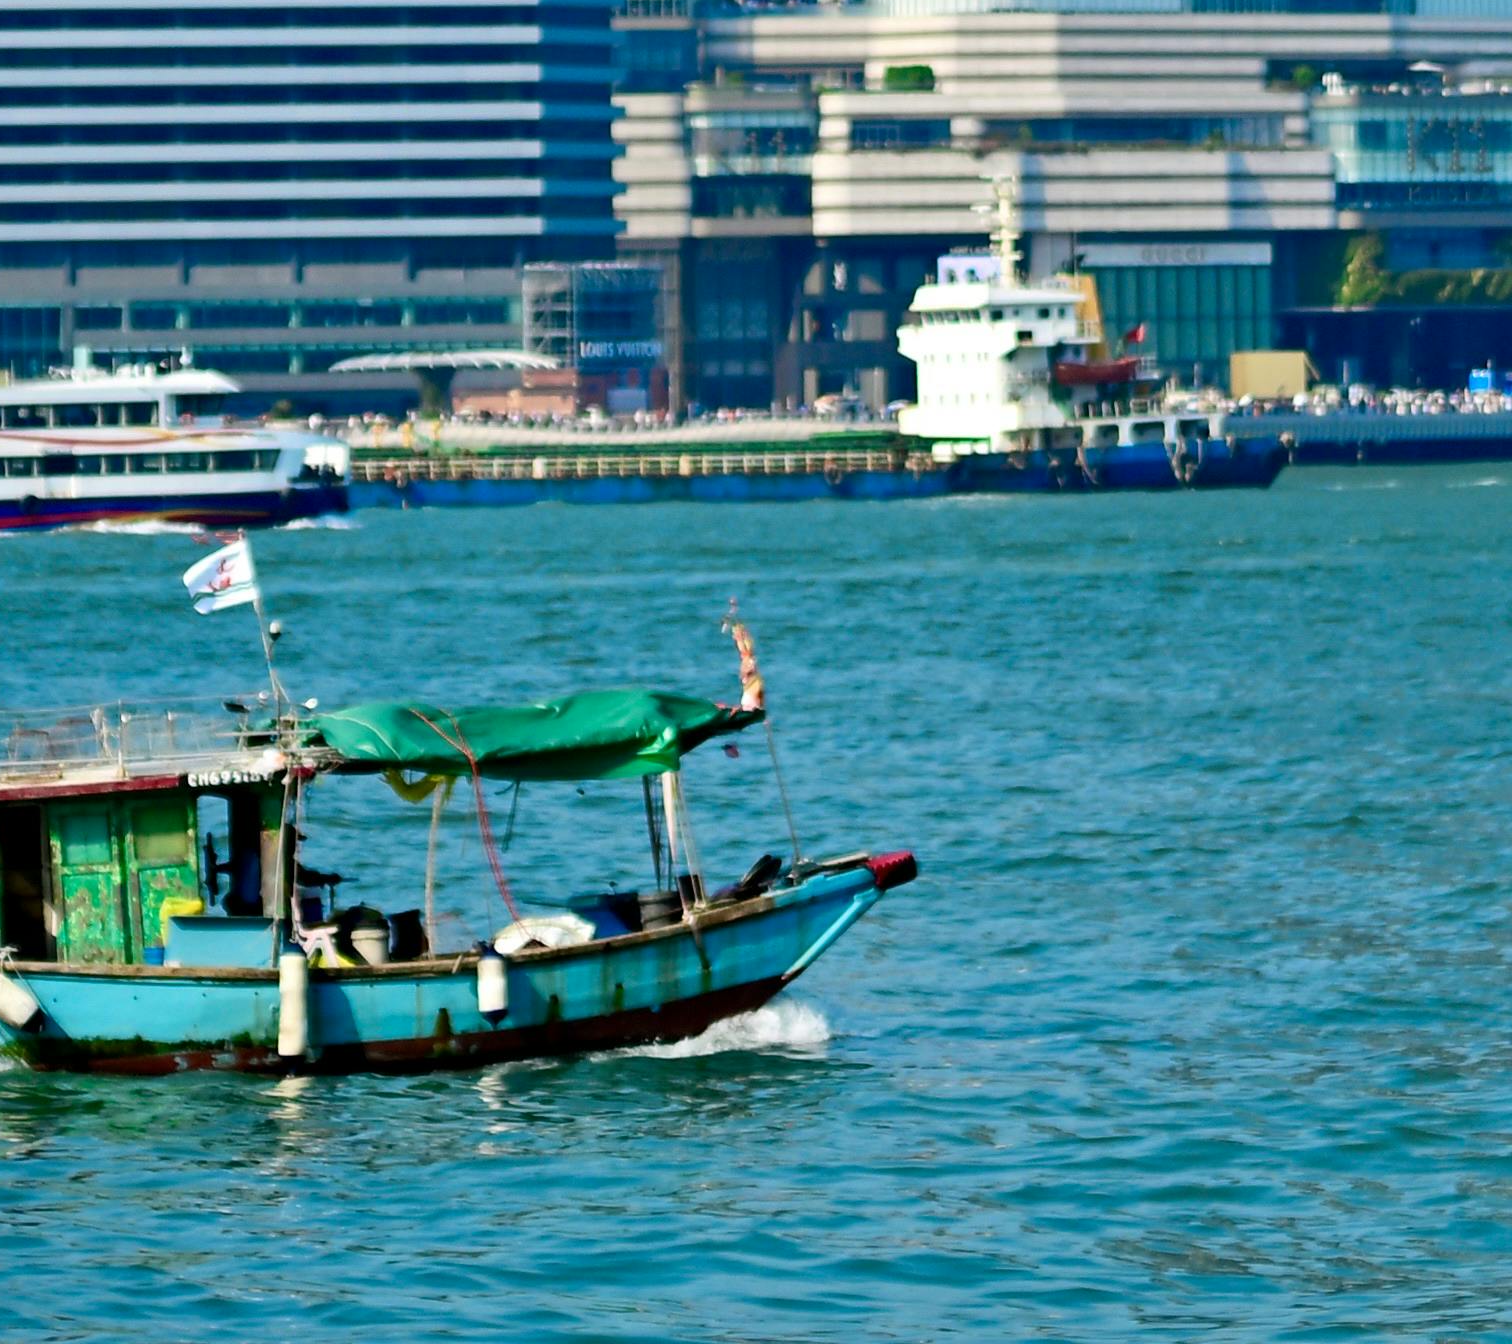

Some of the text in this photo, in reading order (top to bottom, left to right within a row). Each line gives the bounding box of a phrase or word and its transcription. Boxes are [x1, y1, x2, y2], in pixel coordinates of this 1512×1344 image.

[1406, 113, 1494, 173] K11
[580, 340, 663, 358] LOUIS VUITTON
